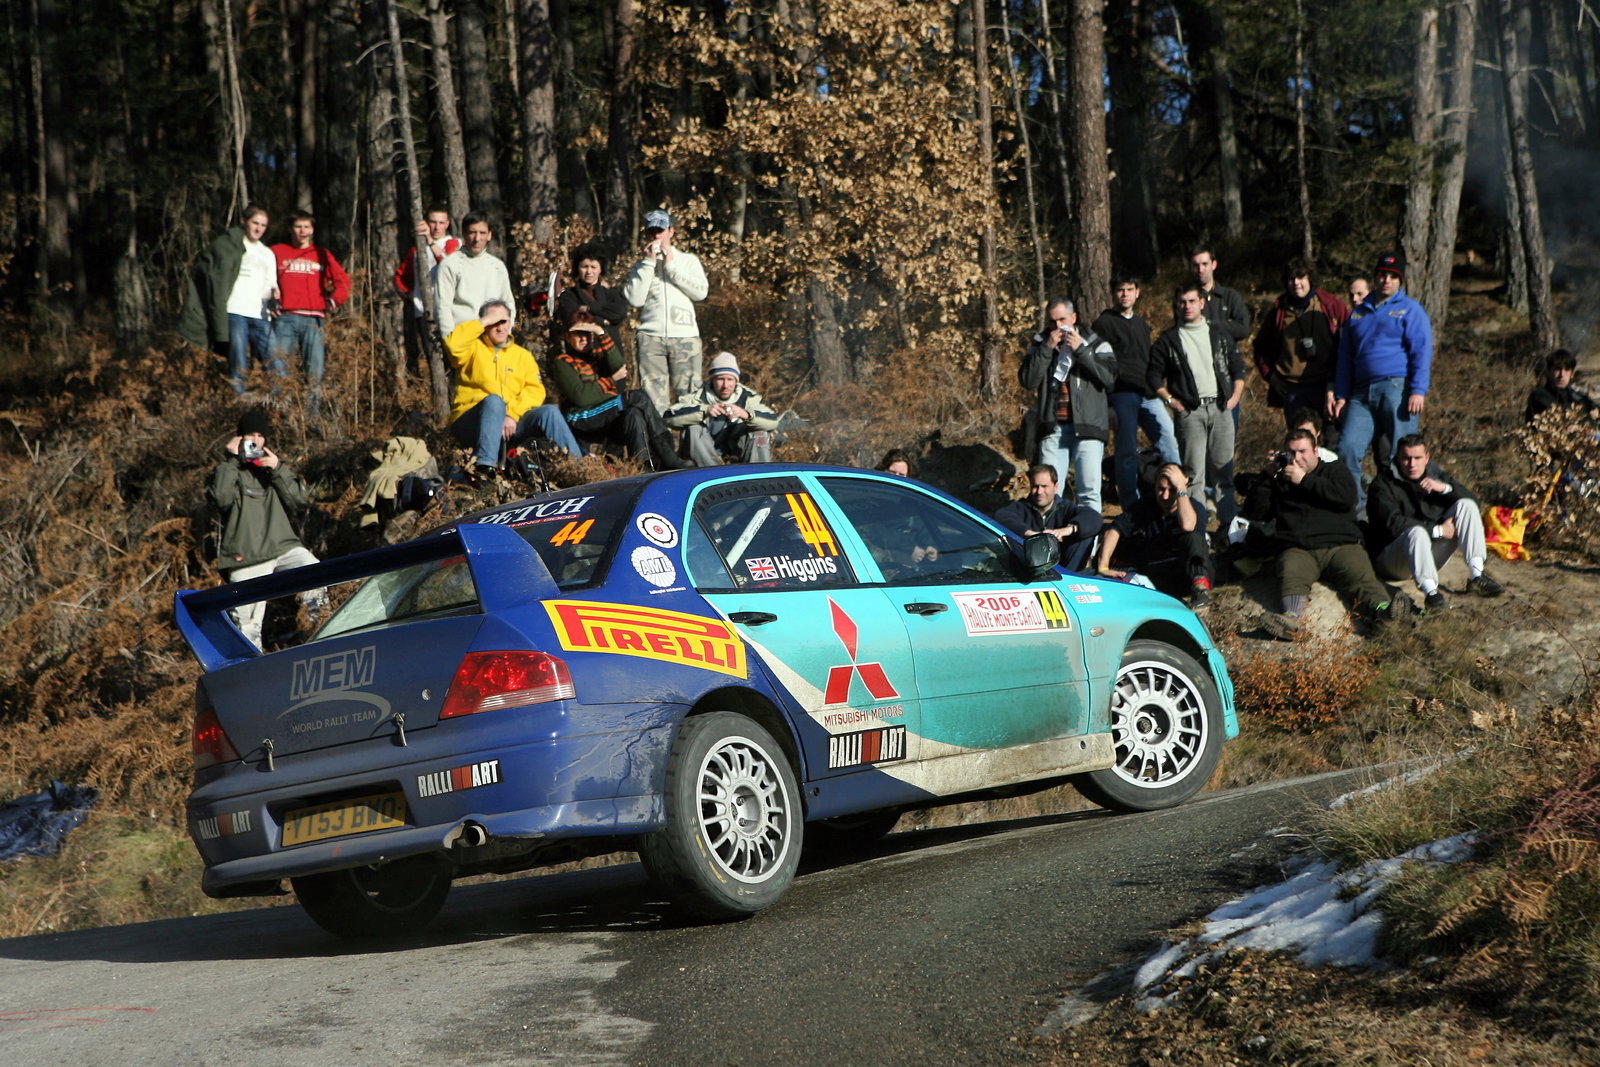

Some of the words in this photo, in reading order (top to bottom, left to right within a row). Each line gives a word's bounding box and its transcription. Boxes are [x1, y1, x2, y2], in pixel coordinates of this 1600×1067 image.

[550, 519, 595, 547] 44
[784, 492, 838, 557] 44
[640, 557, 673, 575] AML
[774, 553, 838, 582] Higgins
[963, 602, 995, 629] RALLYE
[975, 597, 1021, 611] 2006
[1038, 591, 1069, 628] 44
[554, 604, 737, 669] PIRELLI
[290, 645, 376, 700] MEM
[292, 720, 322, 734] WORLD
[325, 715, 349, 728] RALLY
[352, 710, 377, 723] TEAM
[824, 711, 869, 727] MITSUBISHI
[872, 705, 904, 721] MOTORS
